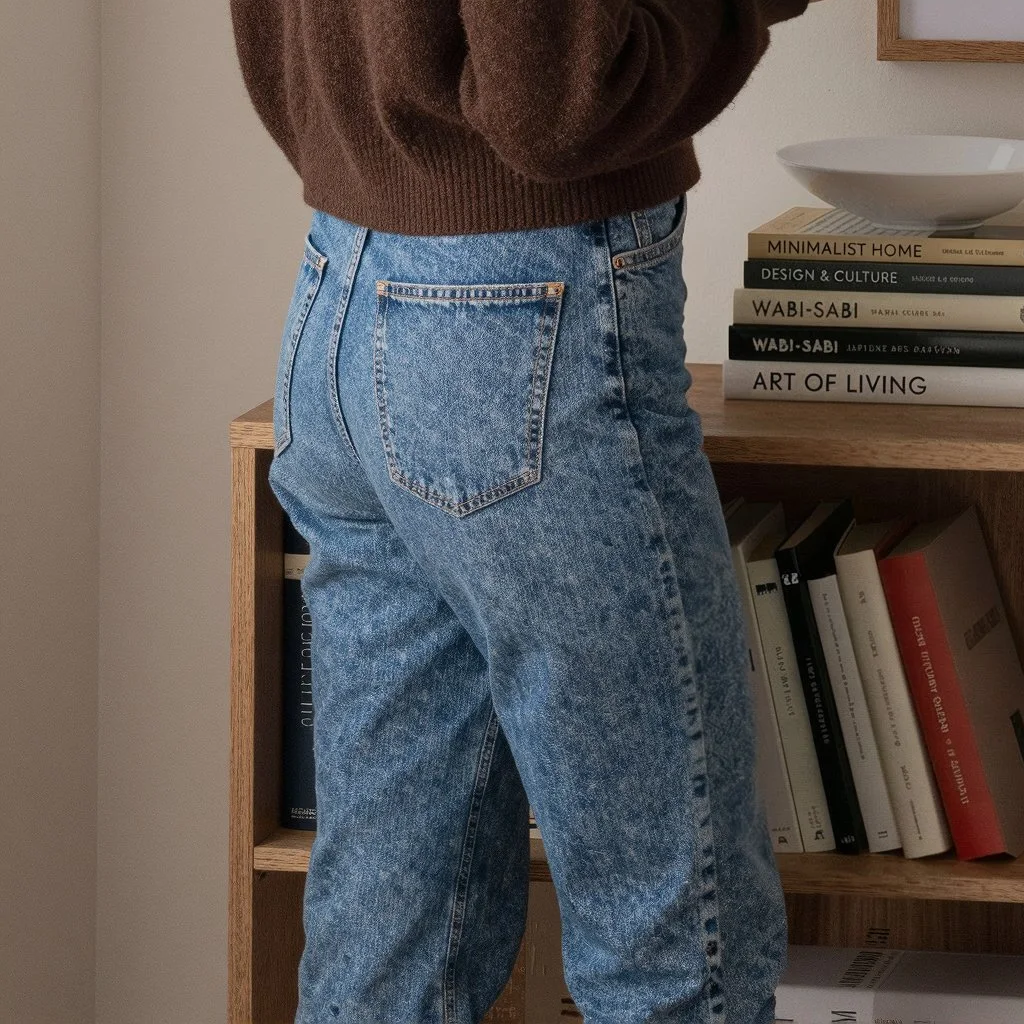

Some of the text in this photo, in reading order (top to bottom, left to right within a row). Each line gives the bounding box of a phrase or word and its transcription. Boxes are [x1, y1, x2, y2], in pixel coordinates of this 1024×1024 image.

[767, 240, 867, 258] MINIMALIST
[872, 243, 922, 259] HOME
[761, 267, 815, 282] DESIGN
[820, 269, 830, 282] &
[834, 269, 898, 284] CULTURE
[752, 299, 859, 319] WABI-SABI
[752, 337, 838, 354] WABI-SABI
[752, 372, 927, 396] ART OF LIVING
